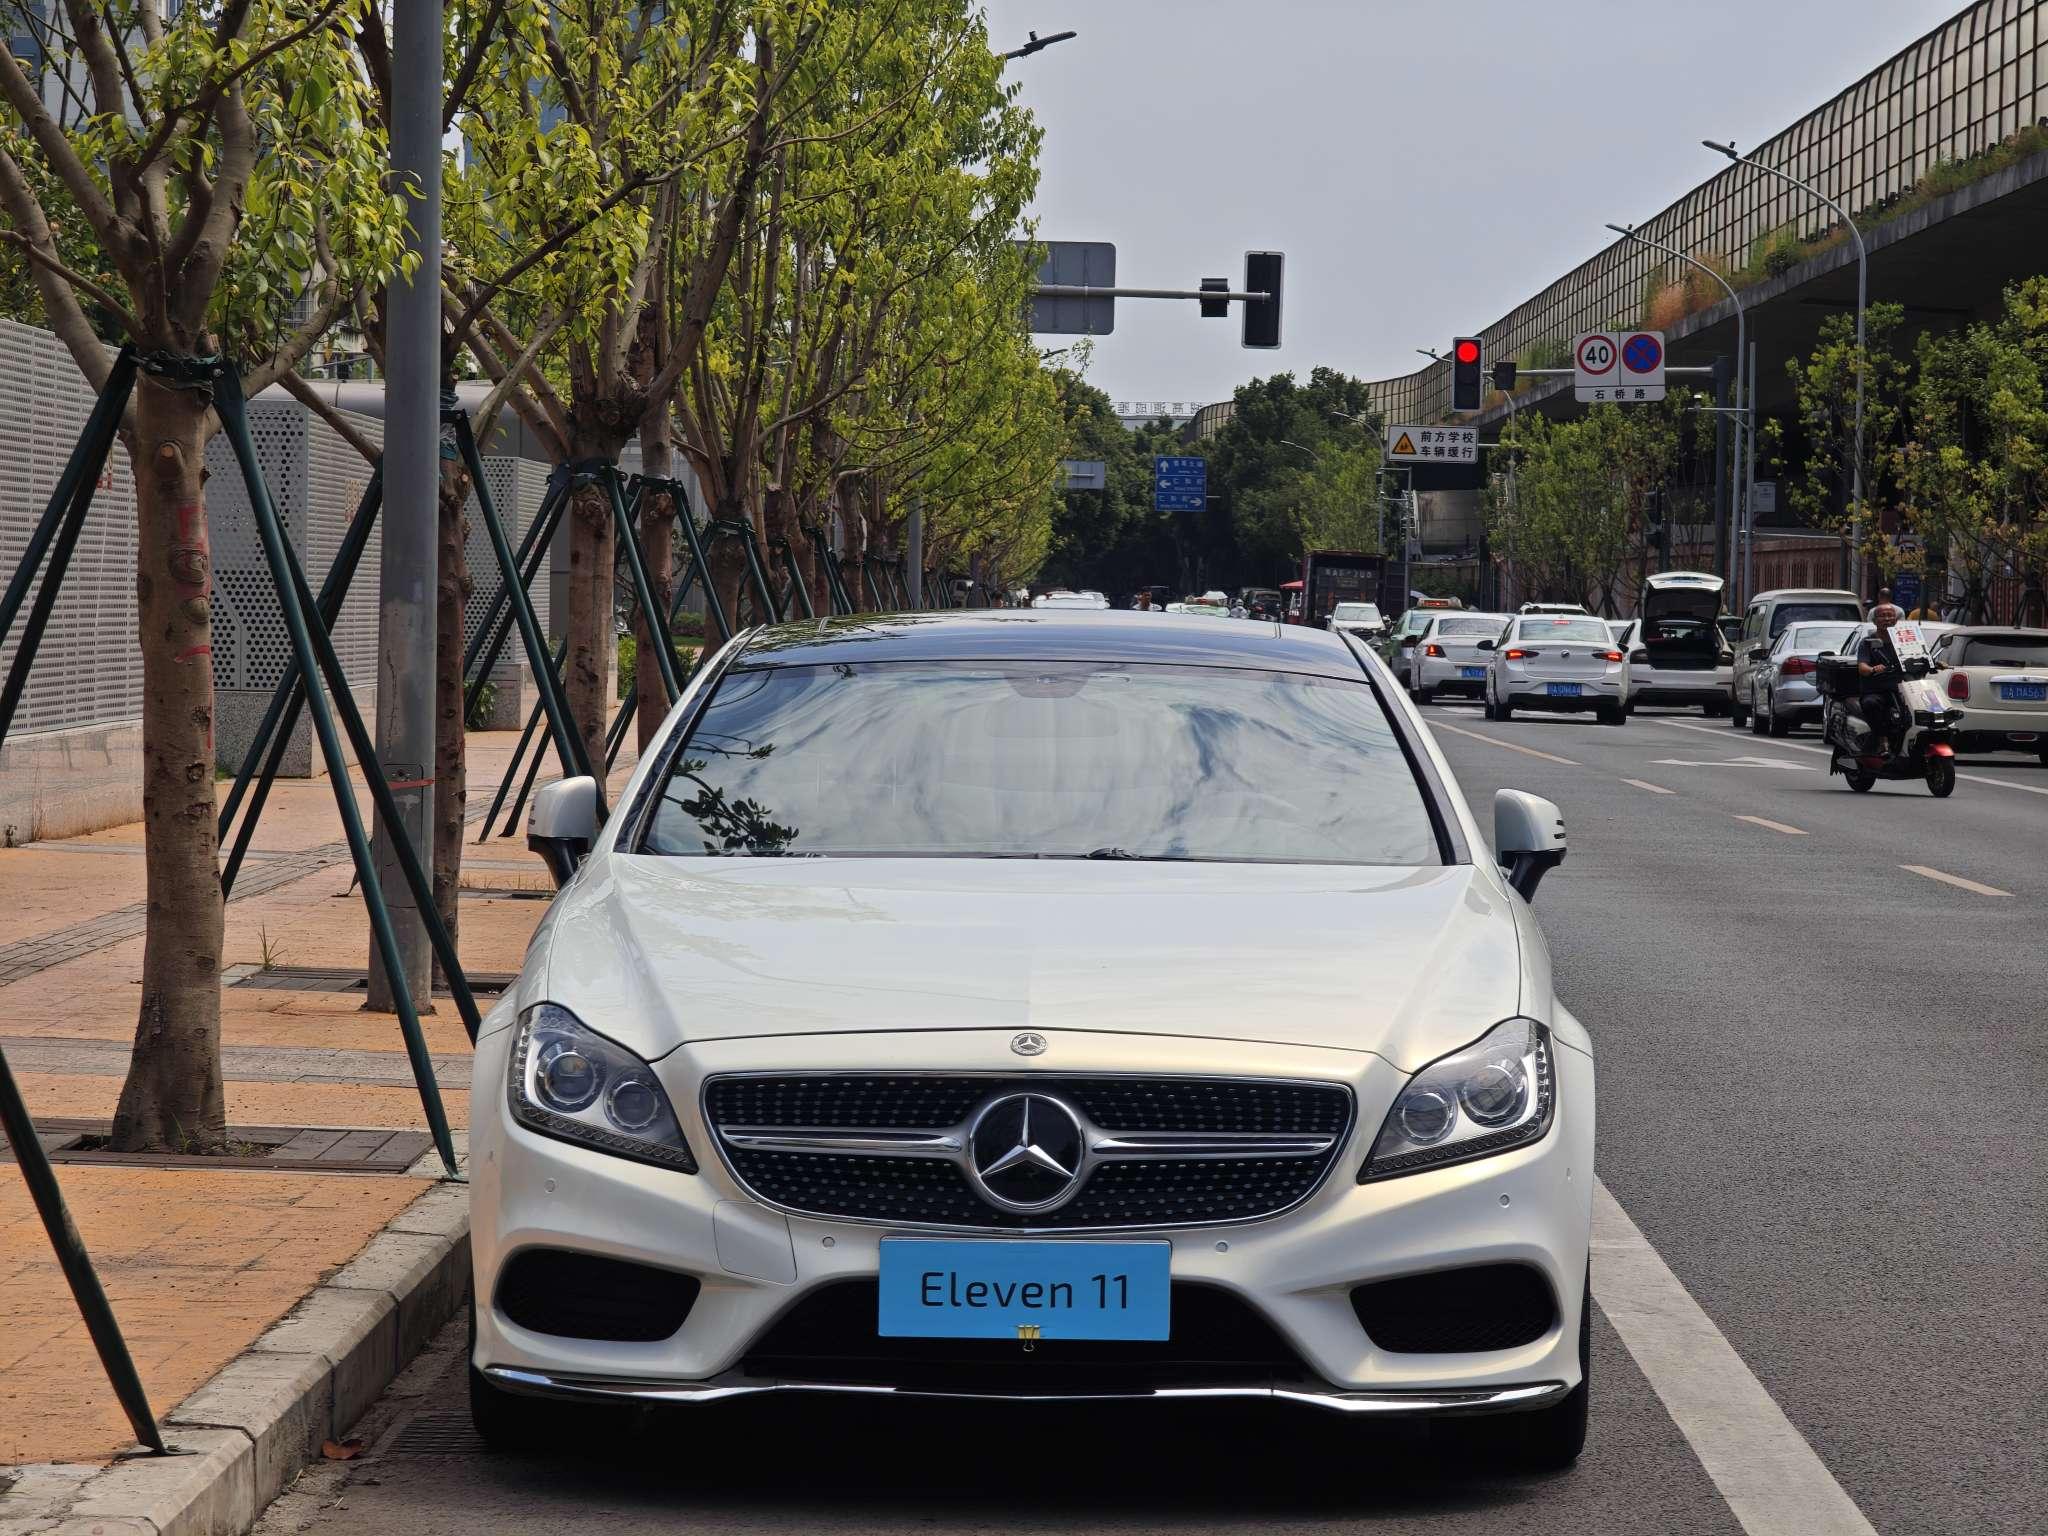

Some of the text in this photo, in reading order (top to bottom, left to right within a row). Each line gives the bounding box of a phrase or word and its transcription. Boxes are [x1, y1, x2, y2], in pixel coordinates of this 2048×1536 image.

[1586, 346, 1609, 364] 40
[1595, 388, 1646, 400] 石桥路
[1420, 431, 1475, 444] 前方学校
[1420, 446, 1474, 459] 车辆缓行
[921, 1271, 1128, 1309] Eleven 11
